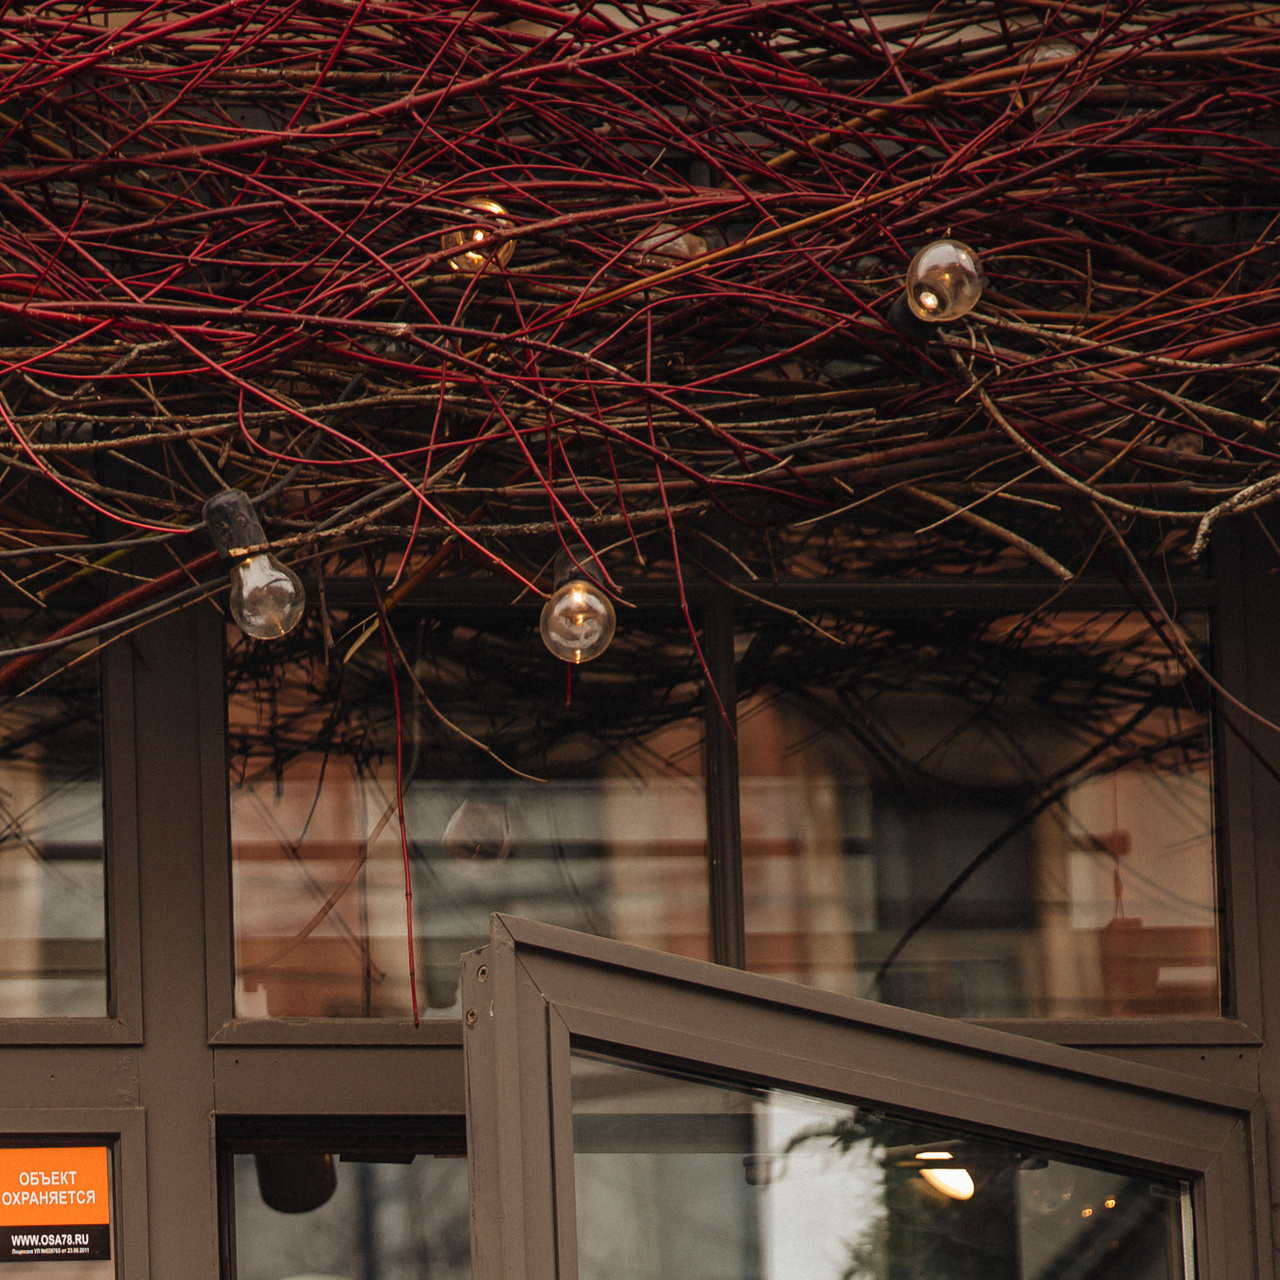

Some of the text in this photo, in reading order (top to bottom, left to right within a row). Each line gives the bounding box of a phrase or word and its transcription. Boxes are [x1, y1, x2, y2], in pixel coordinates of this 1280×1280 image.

[19, 1171, 77, 1186] ОБЪЕКТ
[2, 1190, 95, 1206] ОХРАНЯЕТСЯ
[11, 1234, 89, 1246] WWW.OSA78.RU
